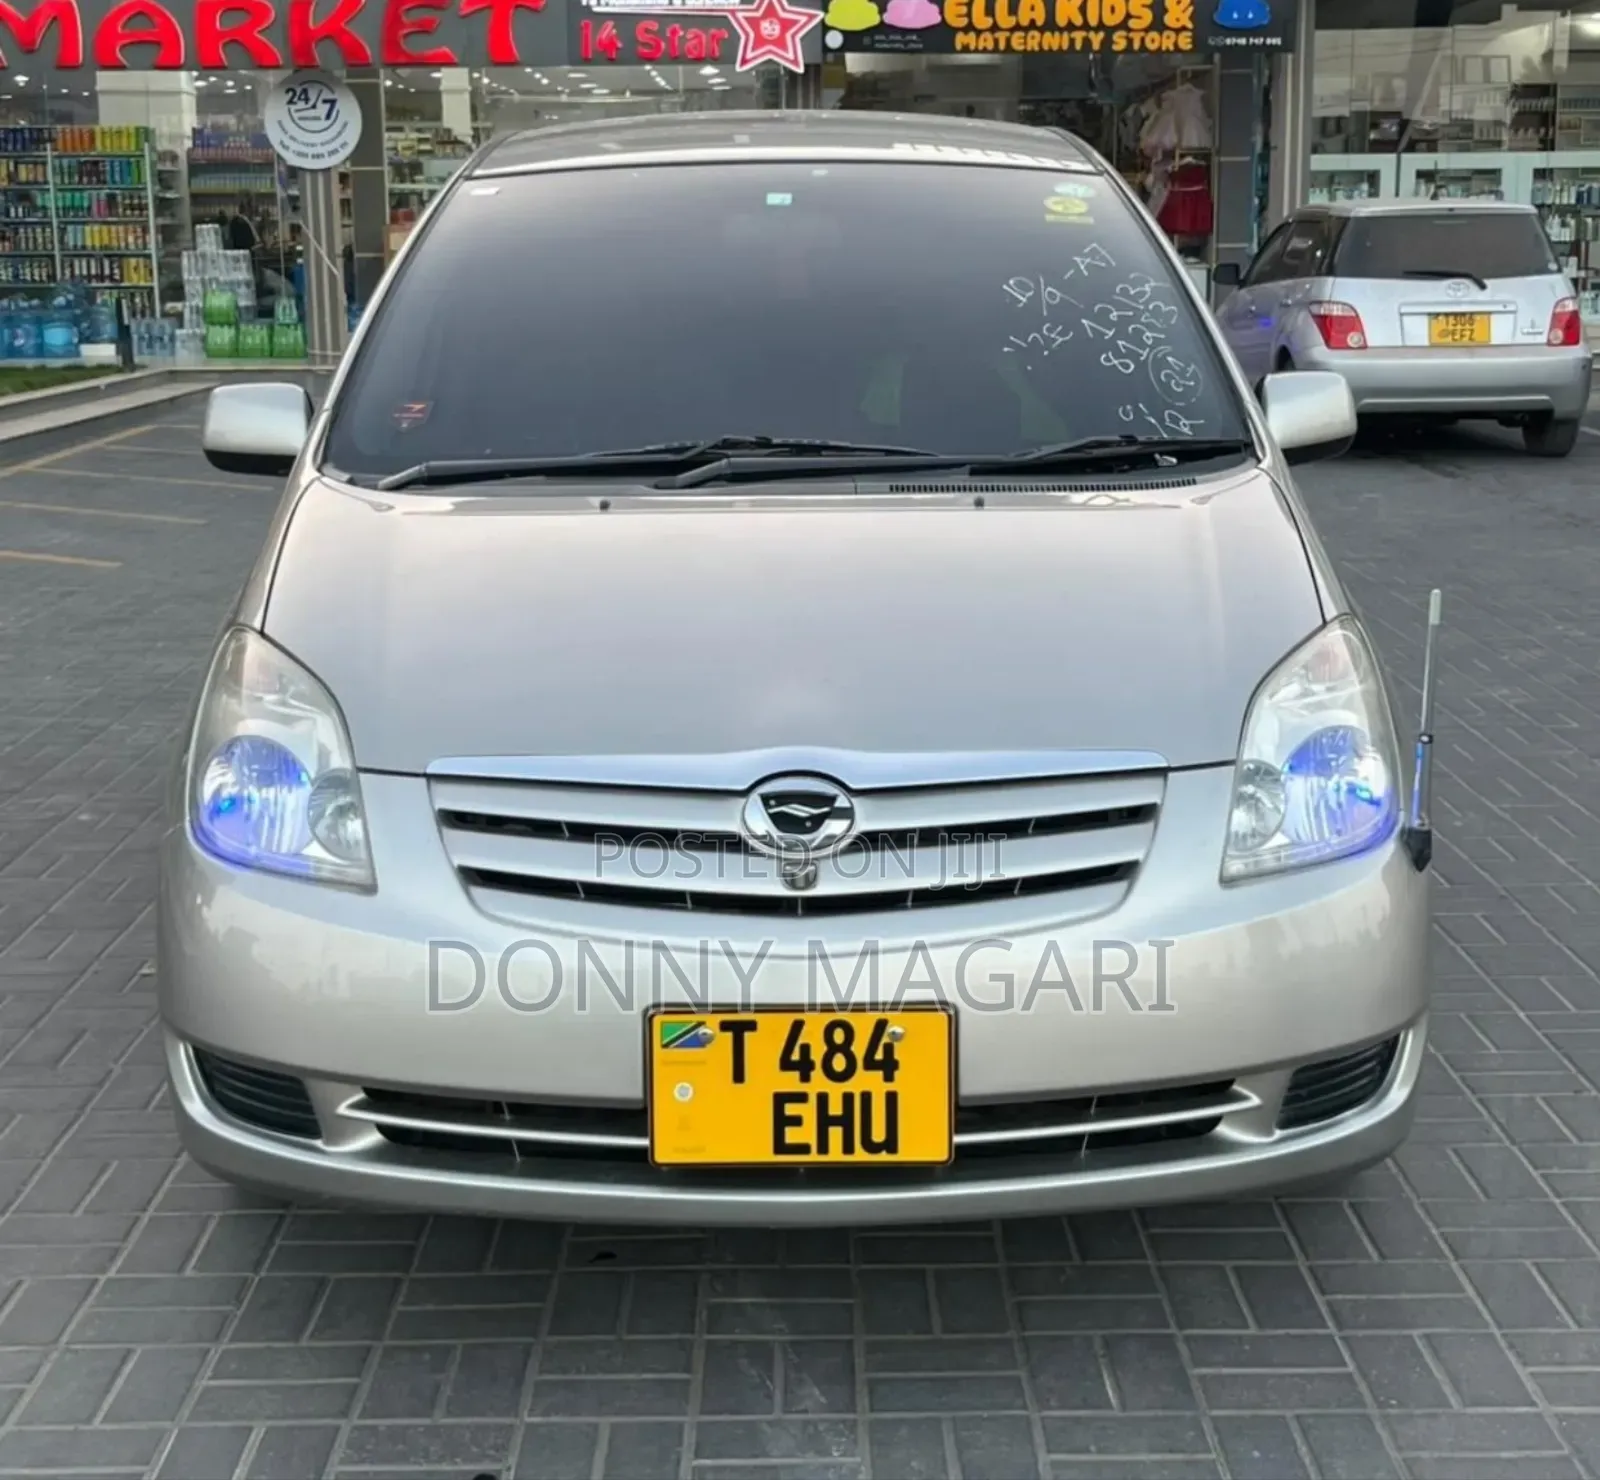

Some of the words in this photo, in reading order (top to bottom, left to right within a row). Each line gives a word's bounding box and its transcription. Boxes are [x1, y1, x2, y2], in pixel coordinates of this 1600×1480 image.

[0, 0, 546, 69] MARKET
[580, 19, 623, 61] 14
[635, 20, 728, 61] Star
[943, 0, 1046, 29] ELLA
[1055, 0, 1153, 30] KIDS
[1163, 0, 1193, 29] &
[954, 31, 1105, 52] MATERNITY
[1112, 31, 1193, 52] STORE
[719, 1019, 758, 1084] T
[779, 1018, 901, 1084] 484
[772, 1090, 899, 1155] EHU
